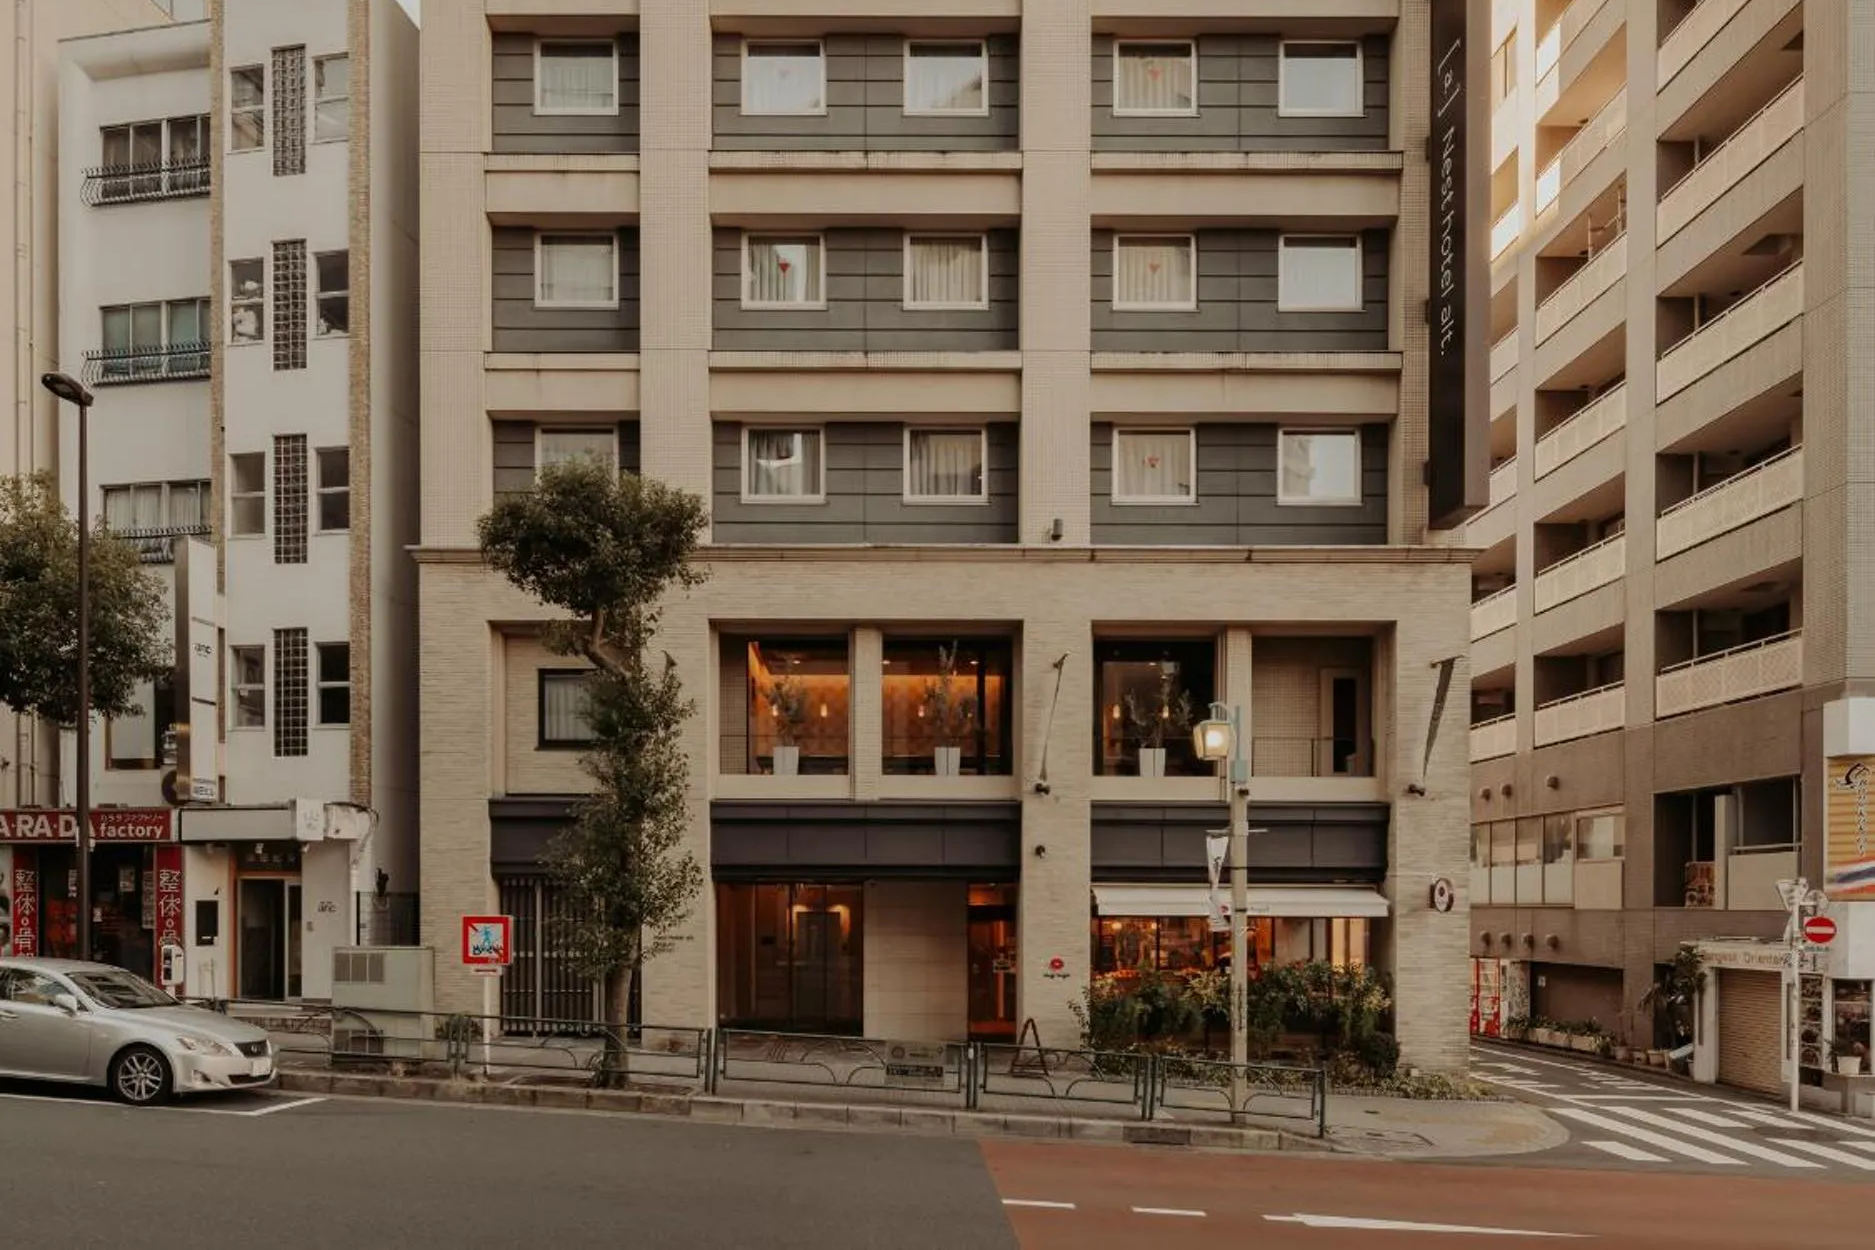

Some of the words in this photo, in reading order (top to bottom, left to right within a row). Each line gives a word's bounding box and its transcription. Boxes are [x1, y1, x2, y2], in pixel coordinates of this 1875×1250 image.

[1441, 126, 1455, 211] Nest
[1441, 210, 1455, 297] hotel
[1440, 305, 1454, 356] alt.
[100, 821, 164, 839] factory
